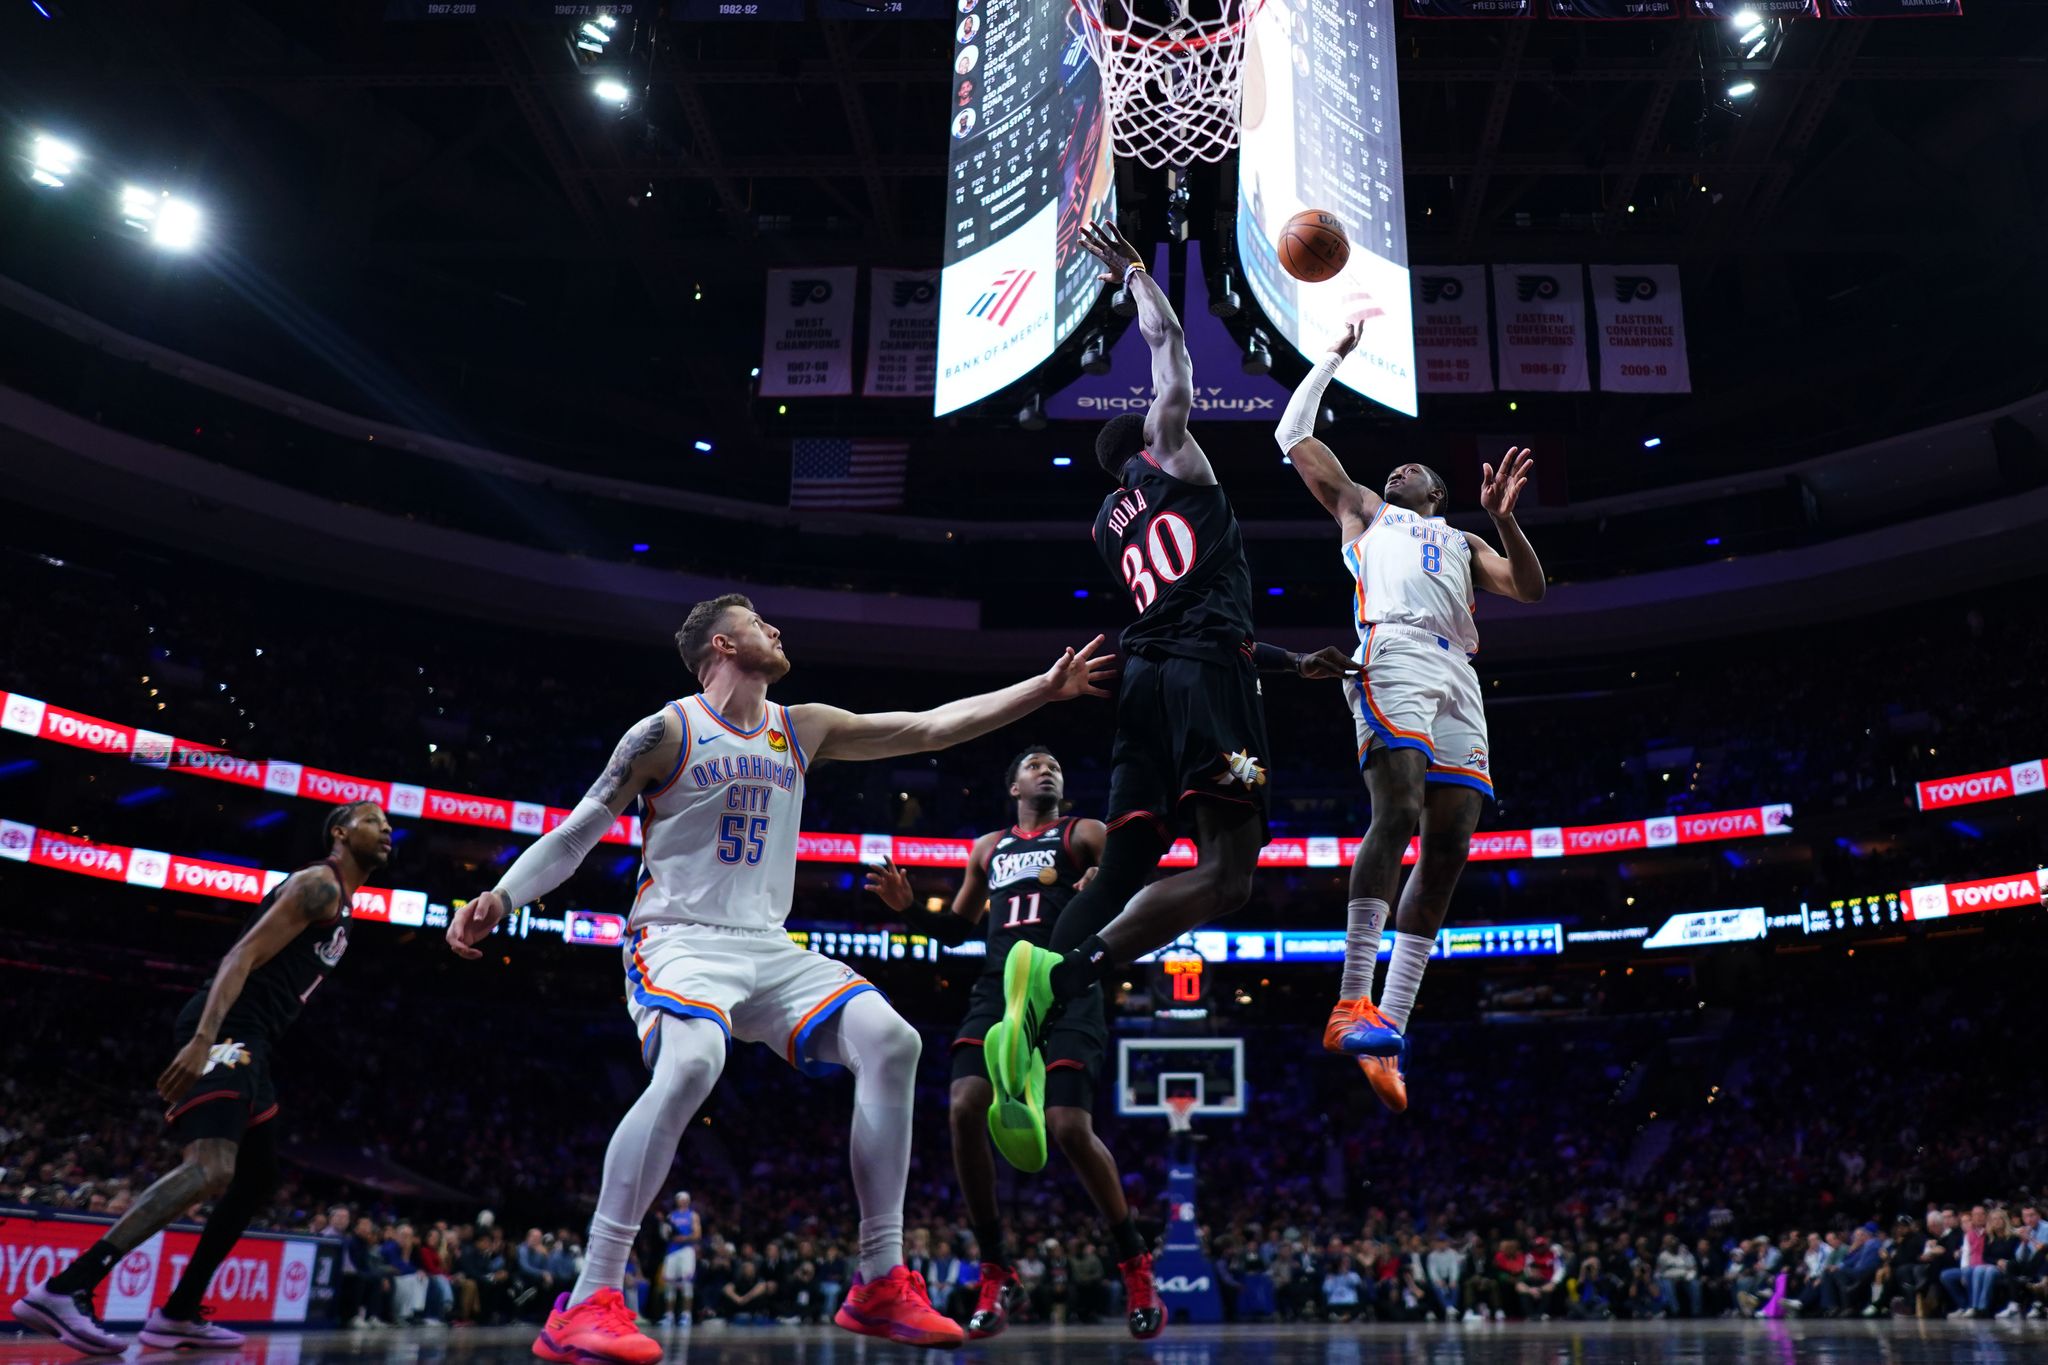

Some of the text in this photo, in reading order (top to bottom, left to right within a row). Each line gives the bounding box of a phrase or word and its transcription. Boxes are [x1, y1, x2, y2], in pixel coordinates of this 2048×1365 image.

[719, 4, 758, 14] 1982-92
[987, 105, 1032, 141] TEAM STATS
[1506, 324, 1575, 335] CONFERENCE
[1516, 313, 1564, 324] EASTERN
[1606, 325, 1674, 336] CONFERENCE
[1615, 314, 1663, 325] EASTERN
[776, 339, 840, 349] CHAMPIONS
[786, 328, 832, 339] DIVISION
[880, 340, 937, 350] CHAMPION
[945, 353, 980, 378] BANK
[984, 345, 998, 361] OF
[1002, 311, 1050, 351] AMERICA
[1509, 335, 1574, 346] CHAMPIONS
[1609, 337, 1673, 347] CHAMPIONS
[1355, 348, 1407, 379] MERICA
[1621, 364, 1667, 376] 2009-10
[1109, 488, 1148, 538] BONA
[1410, 525, 1450, 546] CITY
[1121, 511, 1197, 615] 30
[1420, 542, 1443, 575] 8
[48, 712, 129, 751] TOYOTA
[177, 745, 261, 781] TOYOTA
[691, 754, 797, 792] OKLAHOMA
[306, 773, 384, 804] TOYOTA
[727, 784, 773, 812] CITY
[1926, 775, 2008, 803] TOYOTA
[430, 795, 507, 823] TOYOTA
[717, 813, 770, 866] 55
[1568, 827, 1642, 849] TOYOTA
[1683, 815, 1758, 836] TOYOTA
[40, 837, 124, 873] TOYOTA
[796, 837, 857, 855] OYOTA
[897, 842, 969, 861] TOYOTA
[1470, 836, 1528, 852] OYOTA
[174, 863, 259, 896] TOYOTA
[1952, 879, 2036, 907] TOYOTA
[1002, 892, 1042, 929] 11
[1173, 973, 1200, 1001] 10
[169, 1254, 270, 1301] TYOTA
